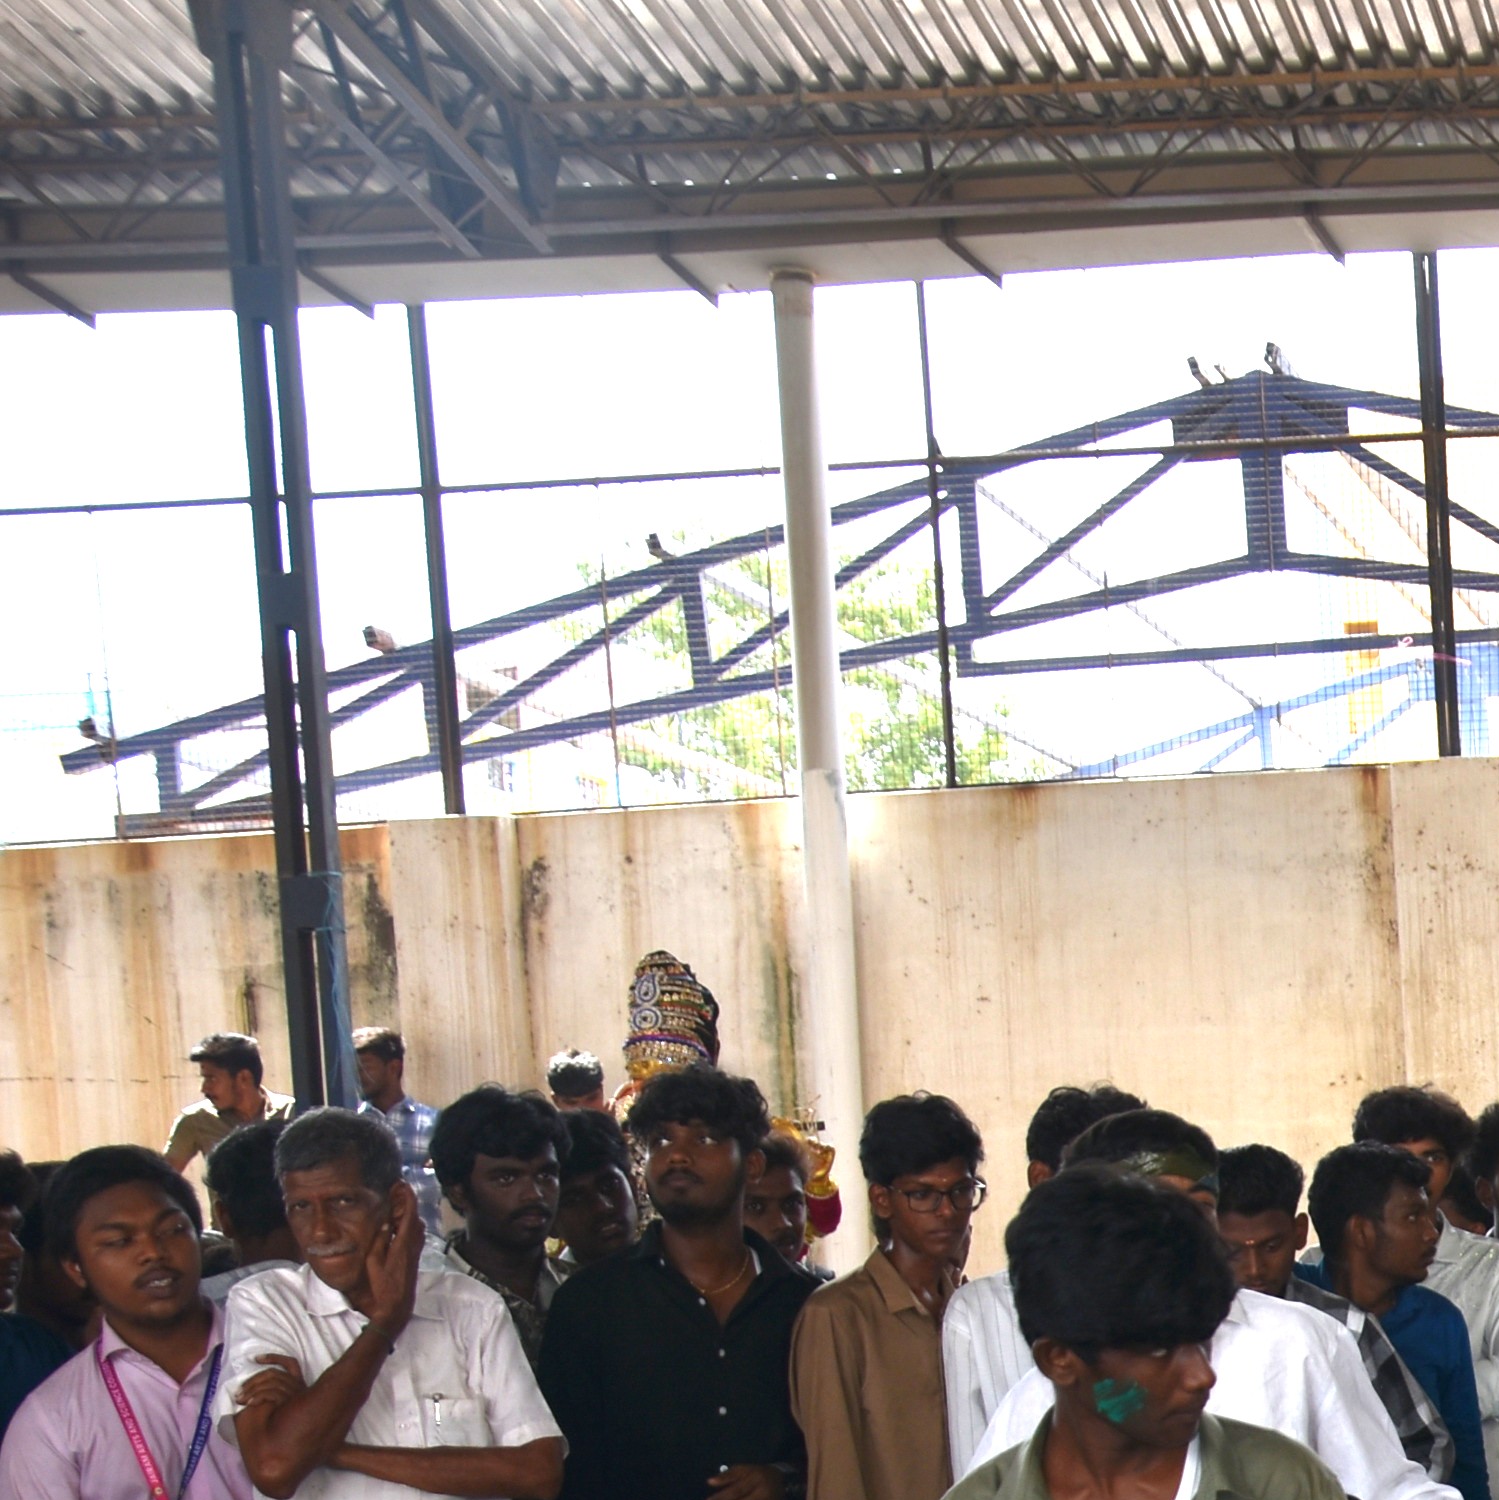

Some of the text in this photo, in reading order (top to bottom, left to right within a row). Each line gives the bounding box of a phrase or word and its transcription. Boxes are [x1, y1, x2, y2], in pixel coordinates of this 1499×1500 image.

[112, 1388, 130, 1418] SCIENCE
[124, 1417, 137, 1434] AND
[197, 1417, 208, 1435] AND
[131, 1434, 145, 1454] ARTS
[192, 1435, 203, 1455] ARTS
[141, 1454, 158, 1483] JAIRAM
